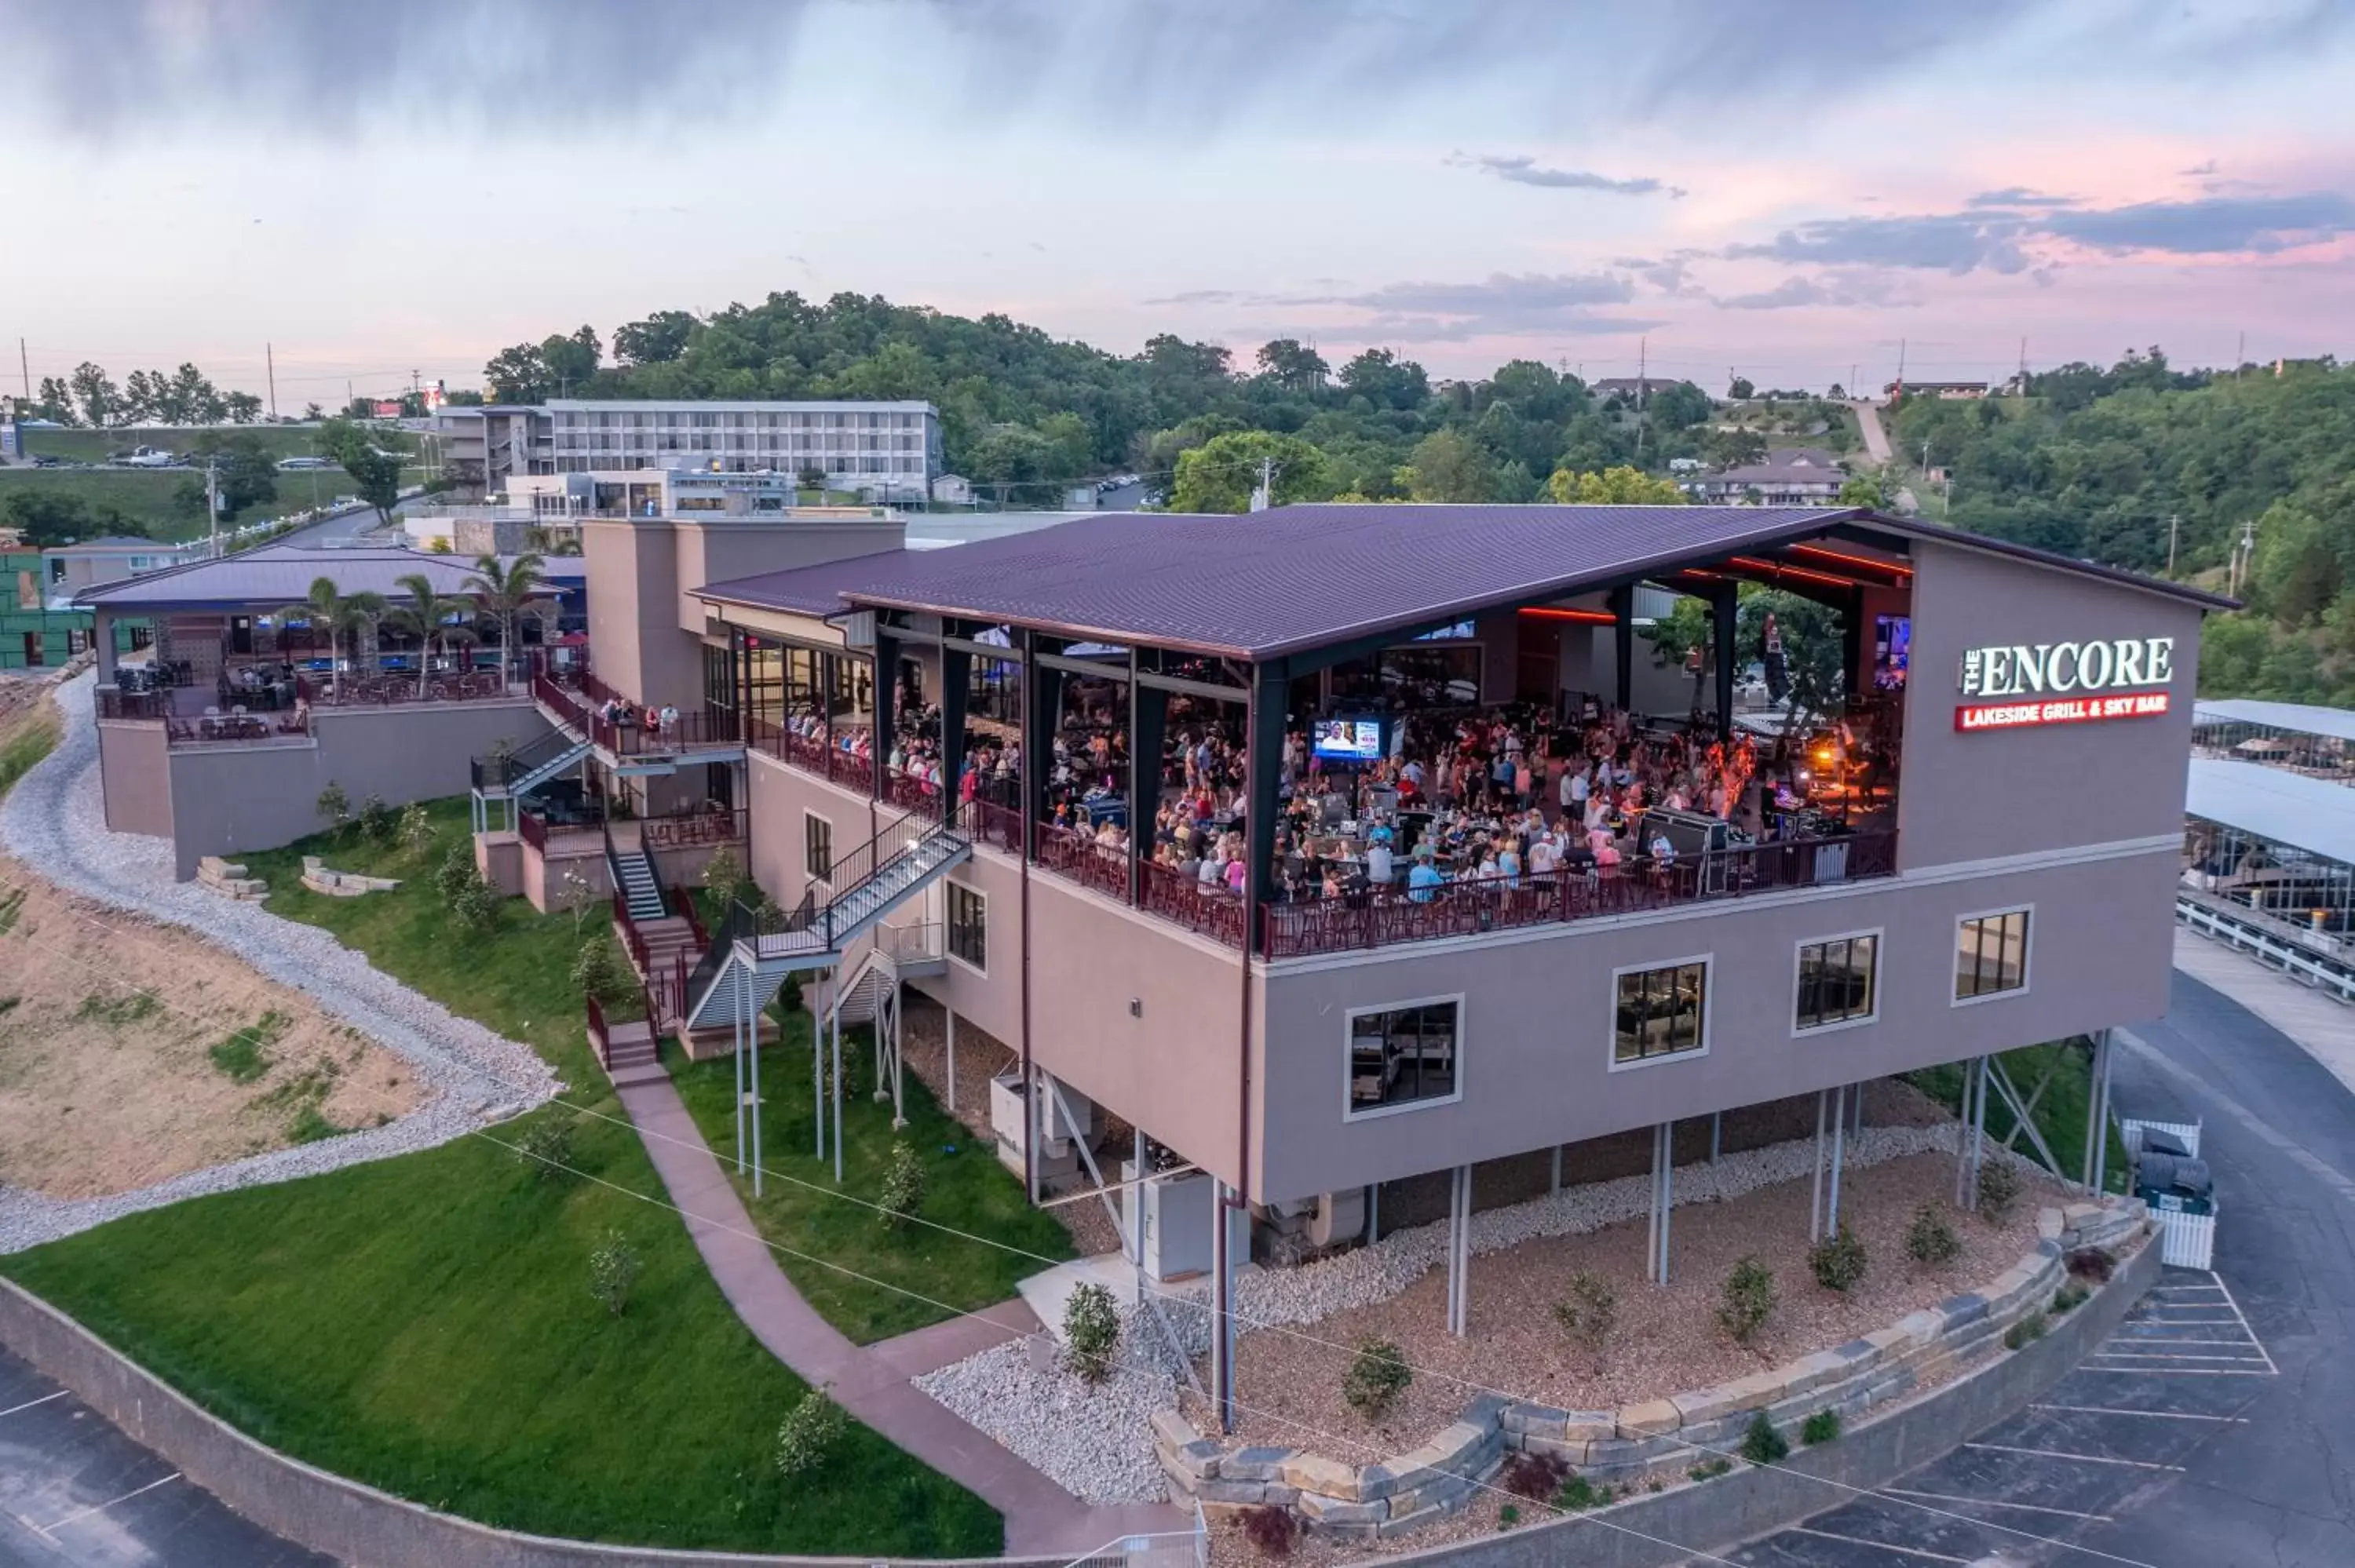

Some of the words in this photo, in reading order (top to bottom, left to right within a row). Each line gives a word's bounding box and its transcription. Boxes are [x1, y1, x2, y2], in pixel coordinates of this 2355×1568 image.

[1963, 649, 1981, 695] THE
[1977, 637, 2174, 696] ENCORE
[1962, 706, 2041, 727] LAKESIDE
[2042, 701, 2087, 720] GRILL
[2088, 700, 2101, 717] &
[2104, 698, 2135, 716] SKY
[2136, 695, 2167, 713] BAR
